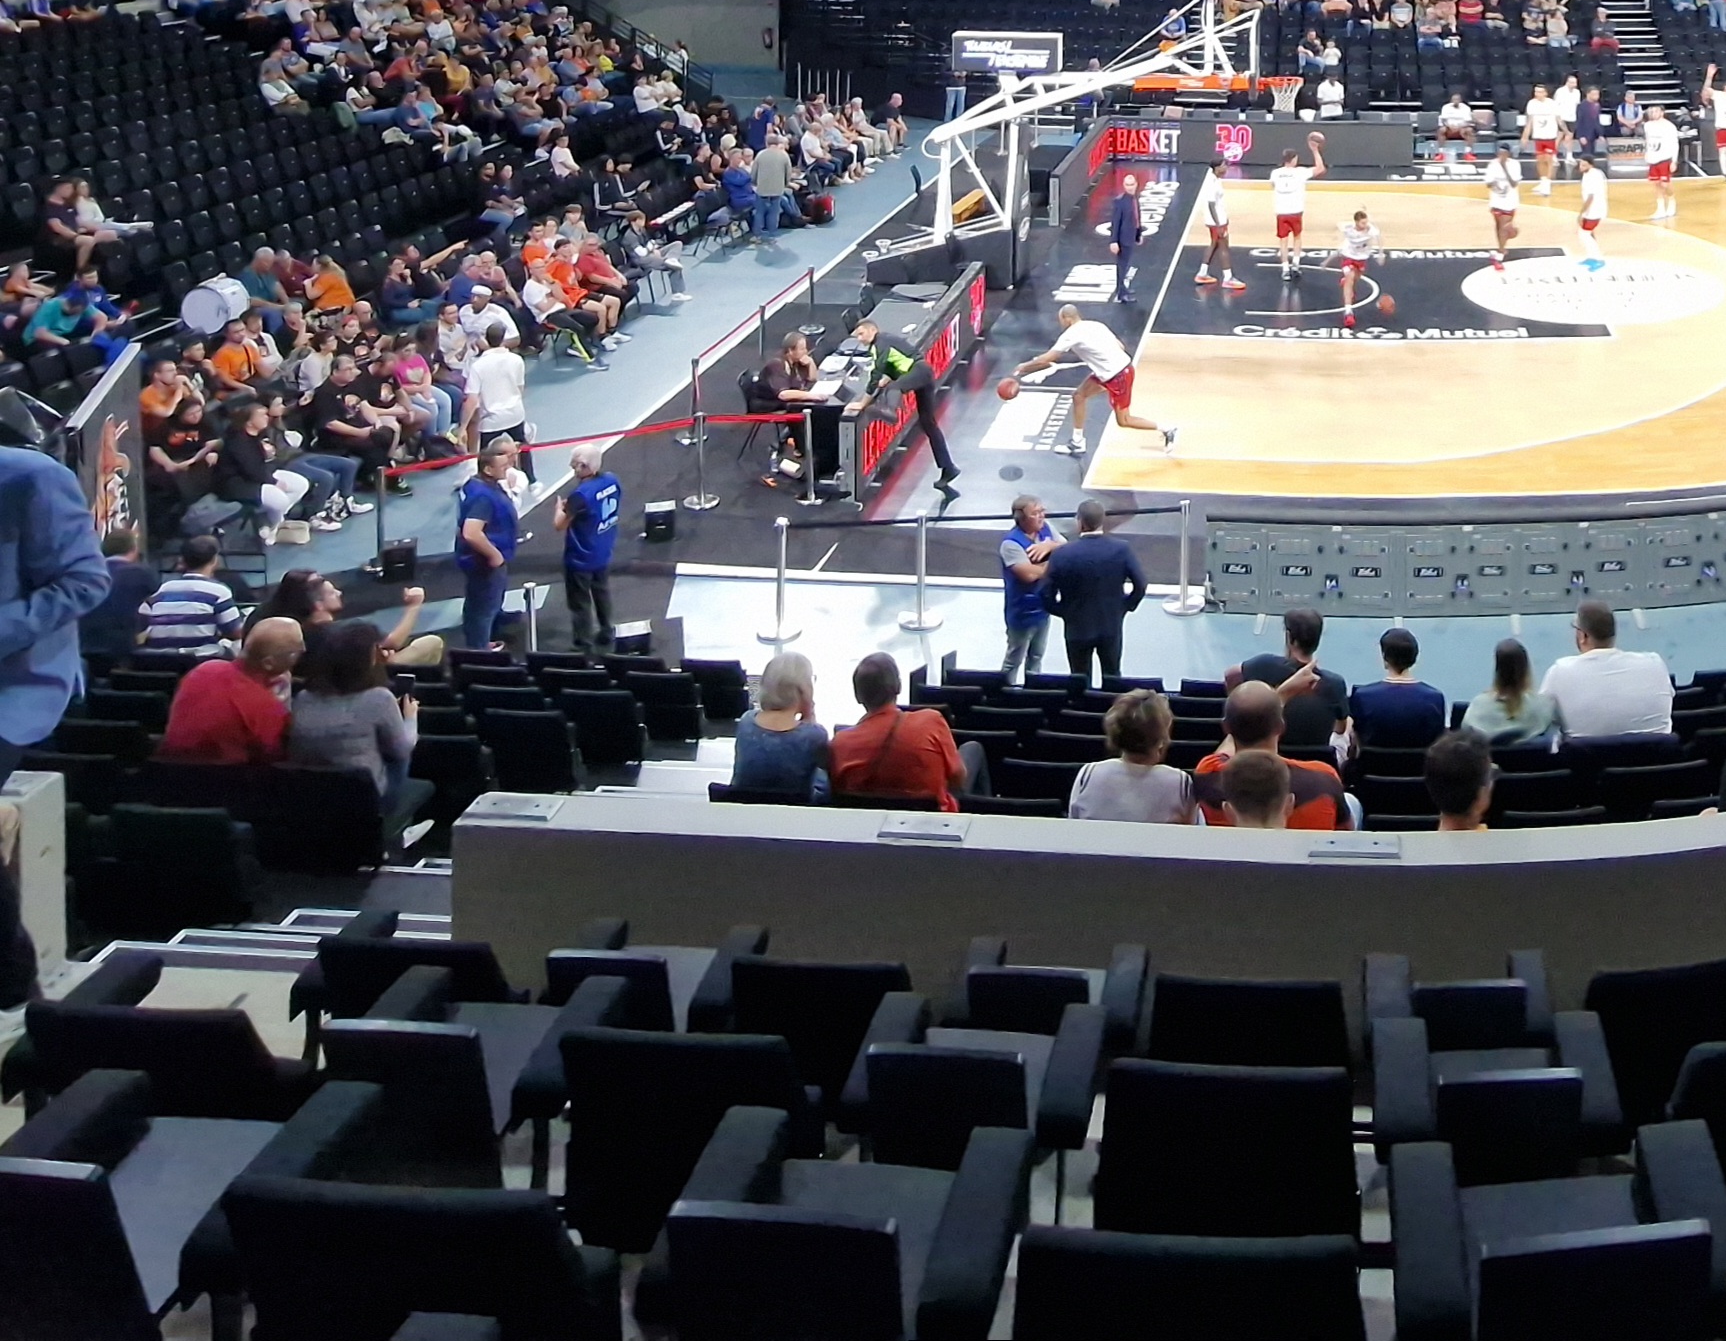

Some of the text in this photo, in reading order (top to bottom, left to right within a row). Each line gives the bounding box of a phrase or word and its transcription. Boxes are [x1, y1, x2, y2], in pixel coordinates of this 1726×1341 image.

[1116, 128, 1182, 155] BASKET
[1232, 323, 1530, 340] Crédit Mutuel
